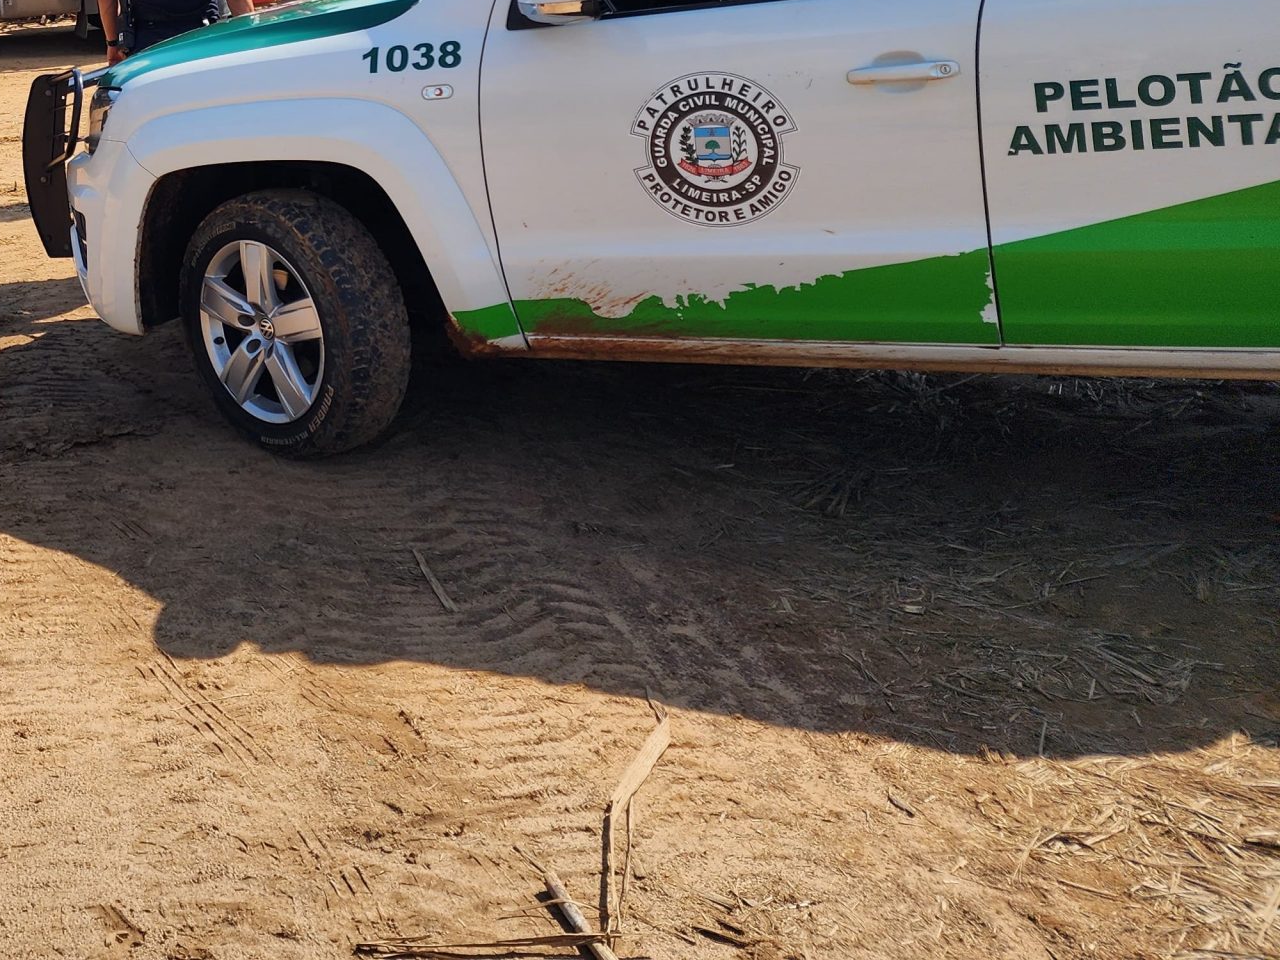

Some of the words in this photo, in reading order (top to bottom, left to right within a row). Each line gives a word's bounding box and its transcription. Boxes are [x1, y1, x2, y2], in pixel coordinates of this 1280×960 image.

[362, 40, 462, 74] 1038
[637, 77, 787, 132] PATRULHEIRO
[1034, 62, 1280, 113] PELOTÃO
[655, 112, 680, 168] GUARDA
[679, 95, 720, 112] CIVIL
[724, 97, 774, 166] MUNICIPAL
[642, 173, 730, 223] PROTETOR
[734, 208, 747, 221] E
[749, 170, 792, 216] AMIGO
[671, 175, 762, 203] LIMEIRA-SP
